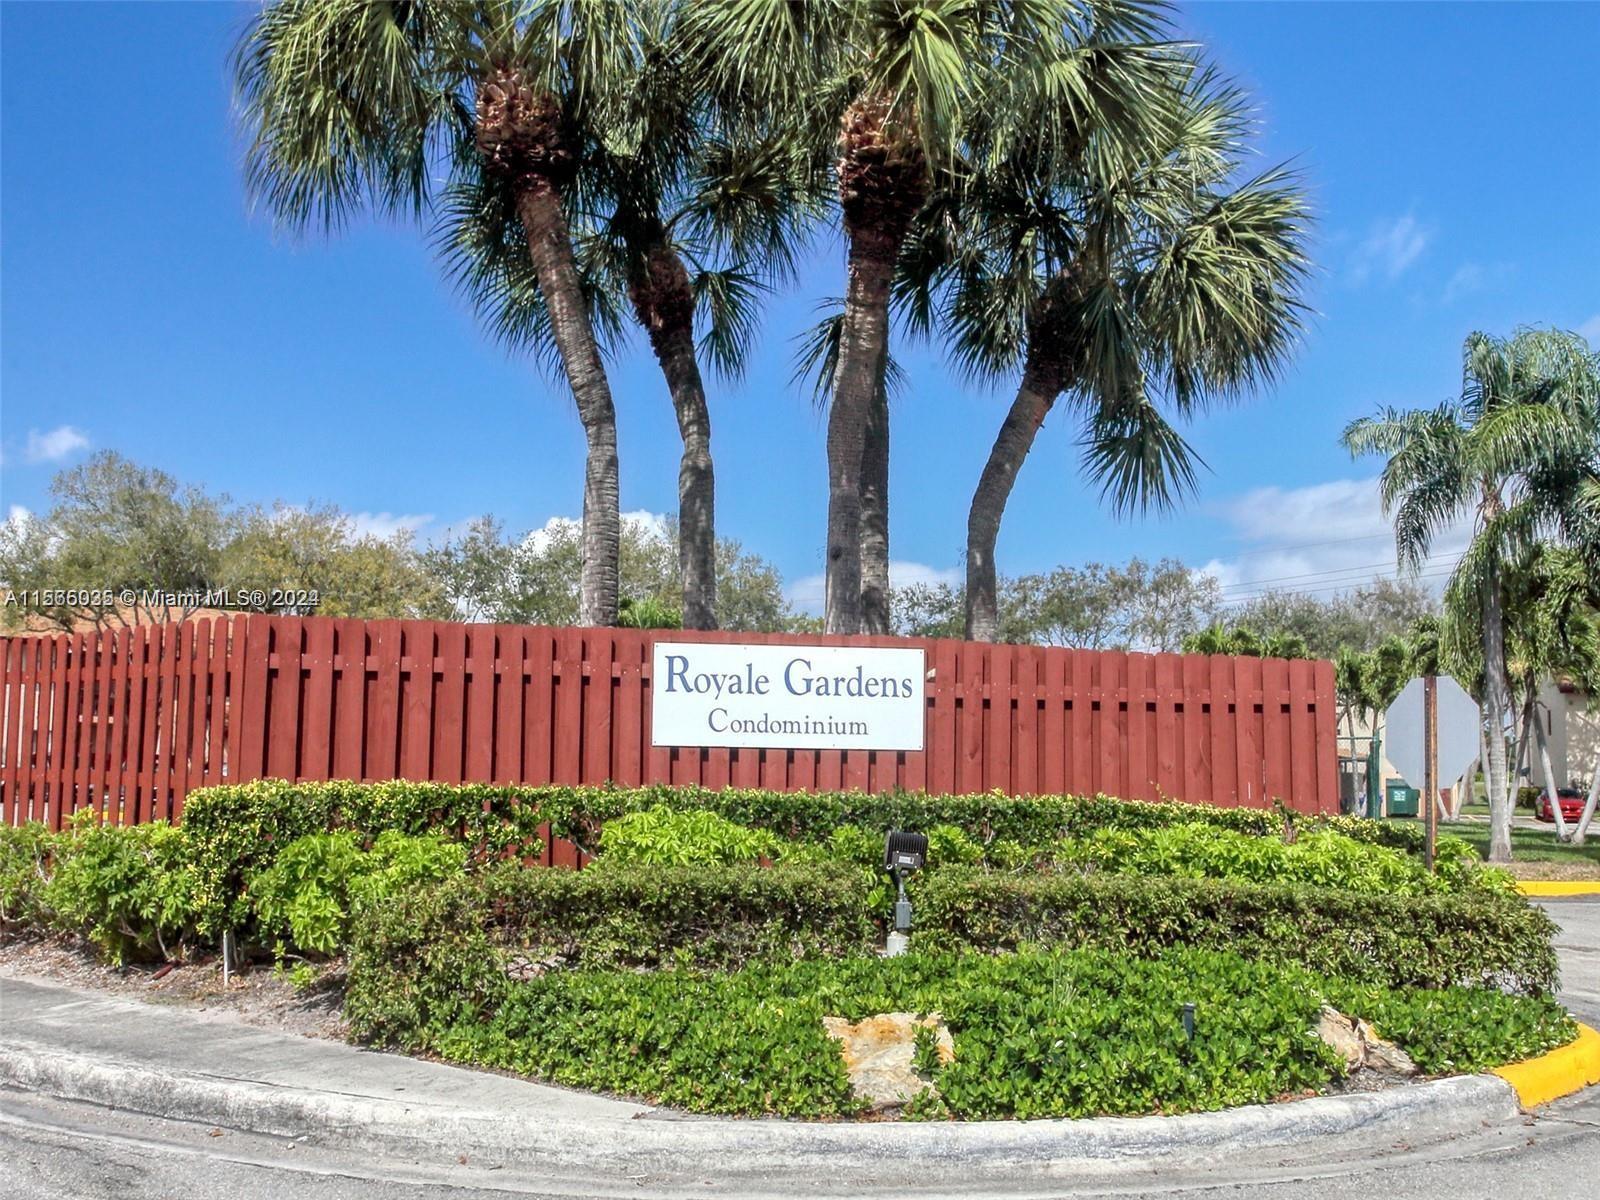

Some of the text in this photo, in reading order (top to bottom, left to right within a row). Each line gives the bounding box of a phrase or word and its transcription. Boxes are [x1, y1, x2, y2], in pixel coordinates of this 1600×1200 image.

[665, 655, 913, 700] Royale Gardens
[708, 708, 869, 735] Condominium
